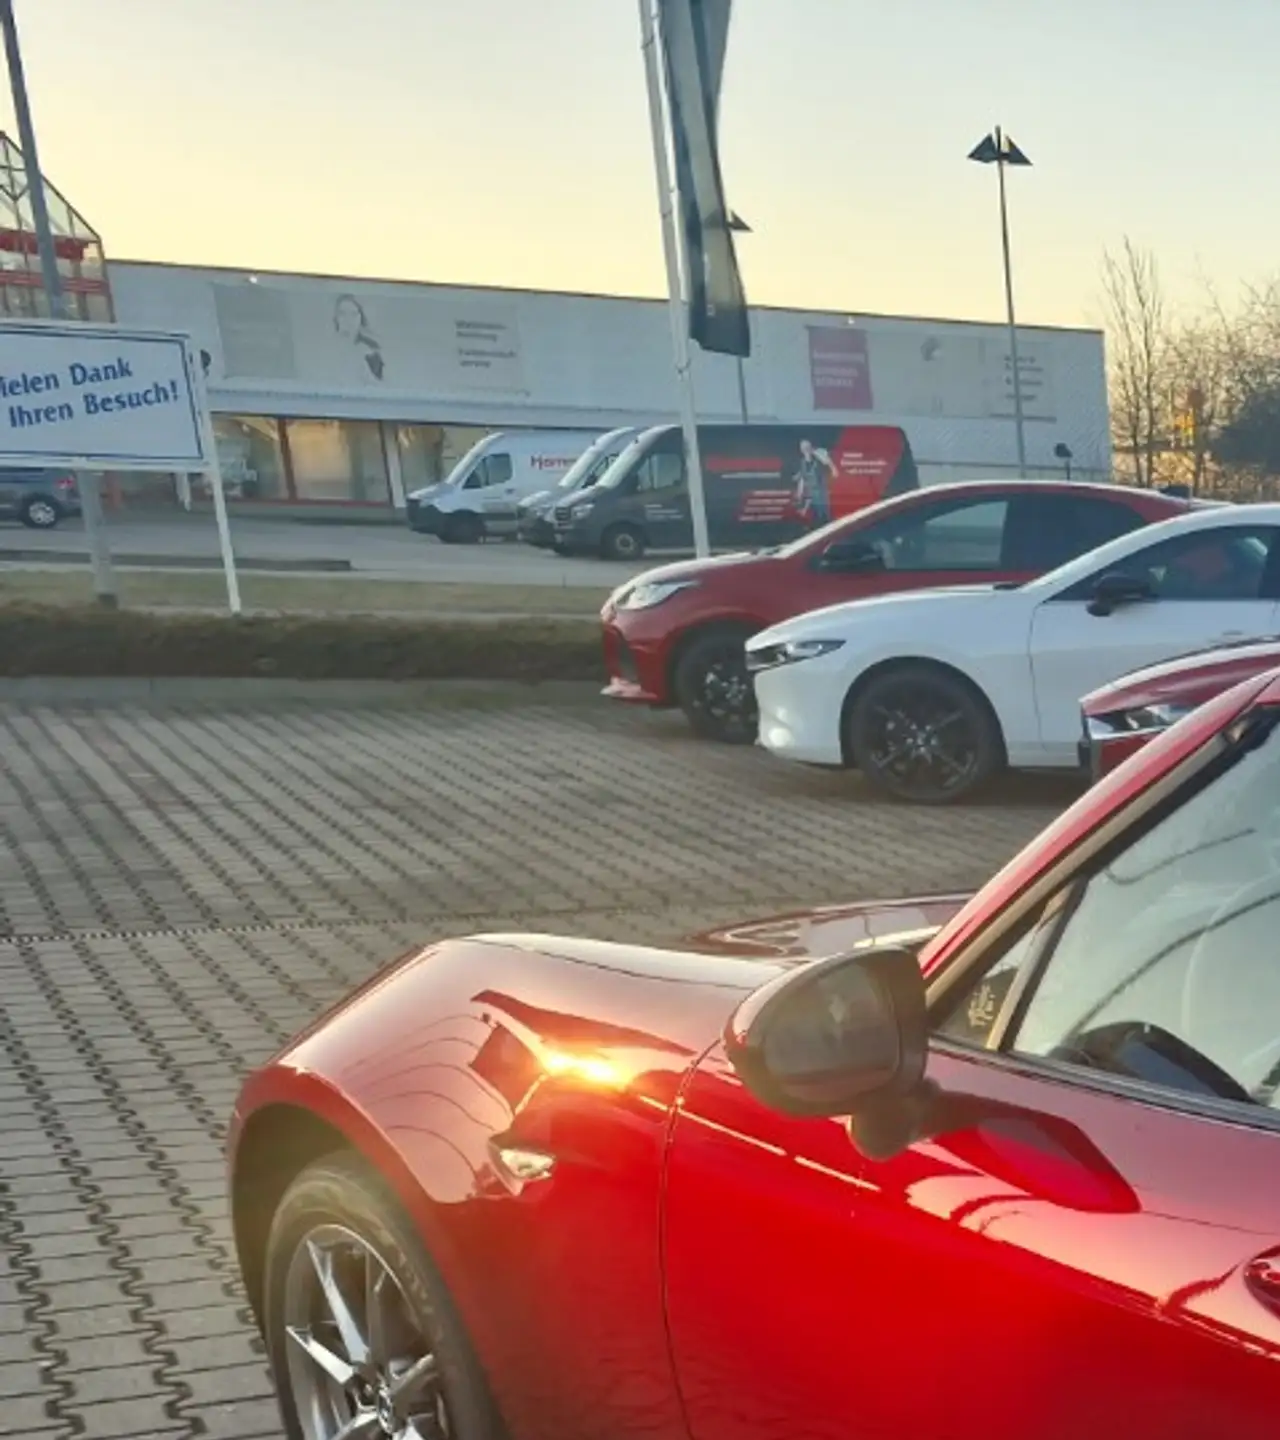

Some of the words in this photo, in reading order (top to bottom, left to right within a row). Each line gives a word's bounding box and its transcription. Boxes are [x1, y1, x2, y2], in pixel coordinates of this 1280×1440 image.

[0, 373, 60, 398] ielen
[69, 357, 133, 386] Dank
[8, 402, 74, 428] Ihren
[82, 379, 178, 415] Besuch!
